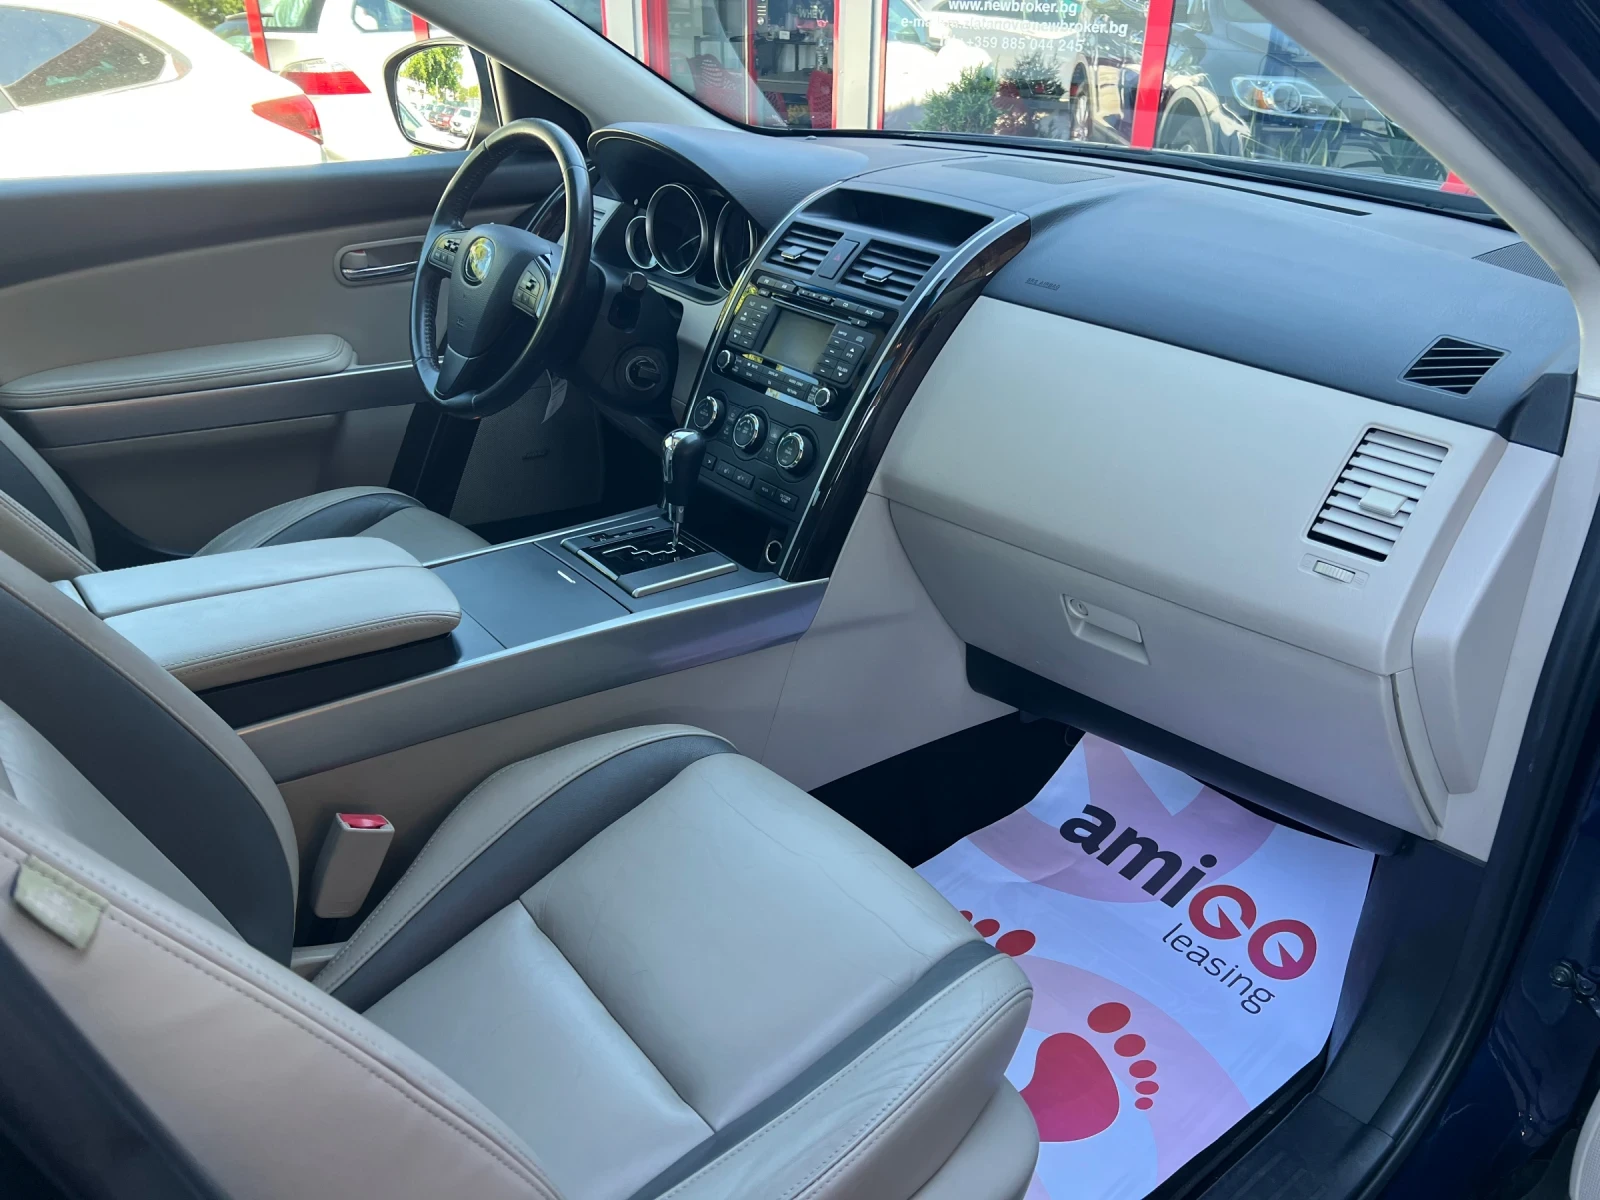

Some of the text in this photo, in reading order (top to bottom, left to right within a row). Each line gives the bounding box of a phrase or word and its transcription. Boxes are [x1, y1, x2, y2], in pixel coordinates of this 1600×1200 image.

[948, 0, 1078, 17] www.newbroker.bg
[967, 35, 998, 49] +359
[1001, 37, 1026, 50] 885
[1030, 38, 1054, 51] 044
[1058, 39, 1084, 53] 245
[1162, 922, 1276, 1015] leasing
